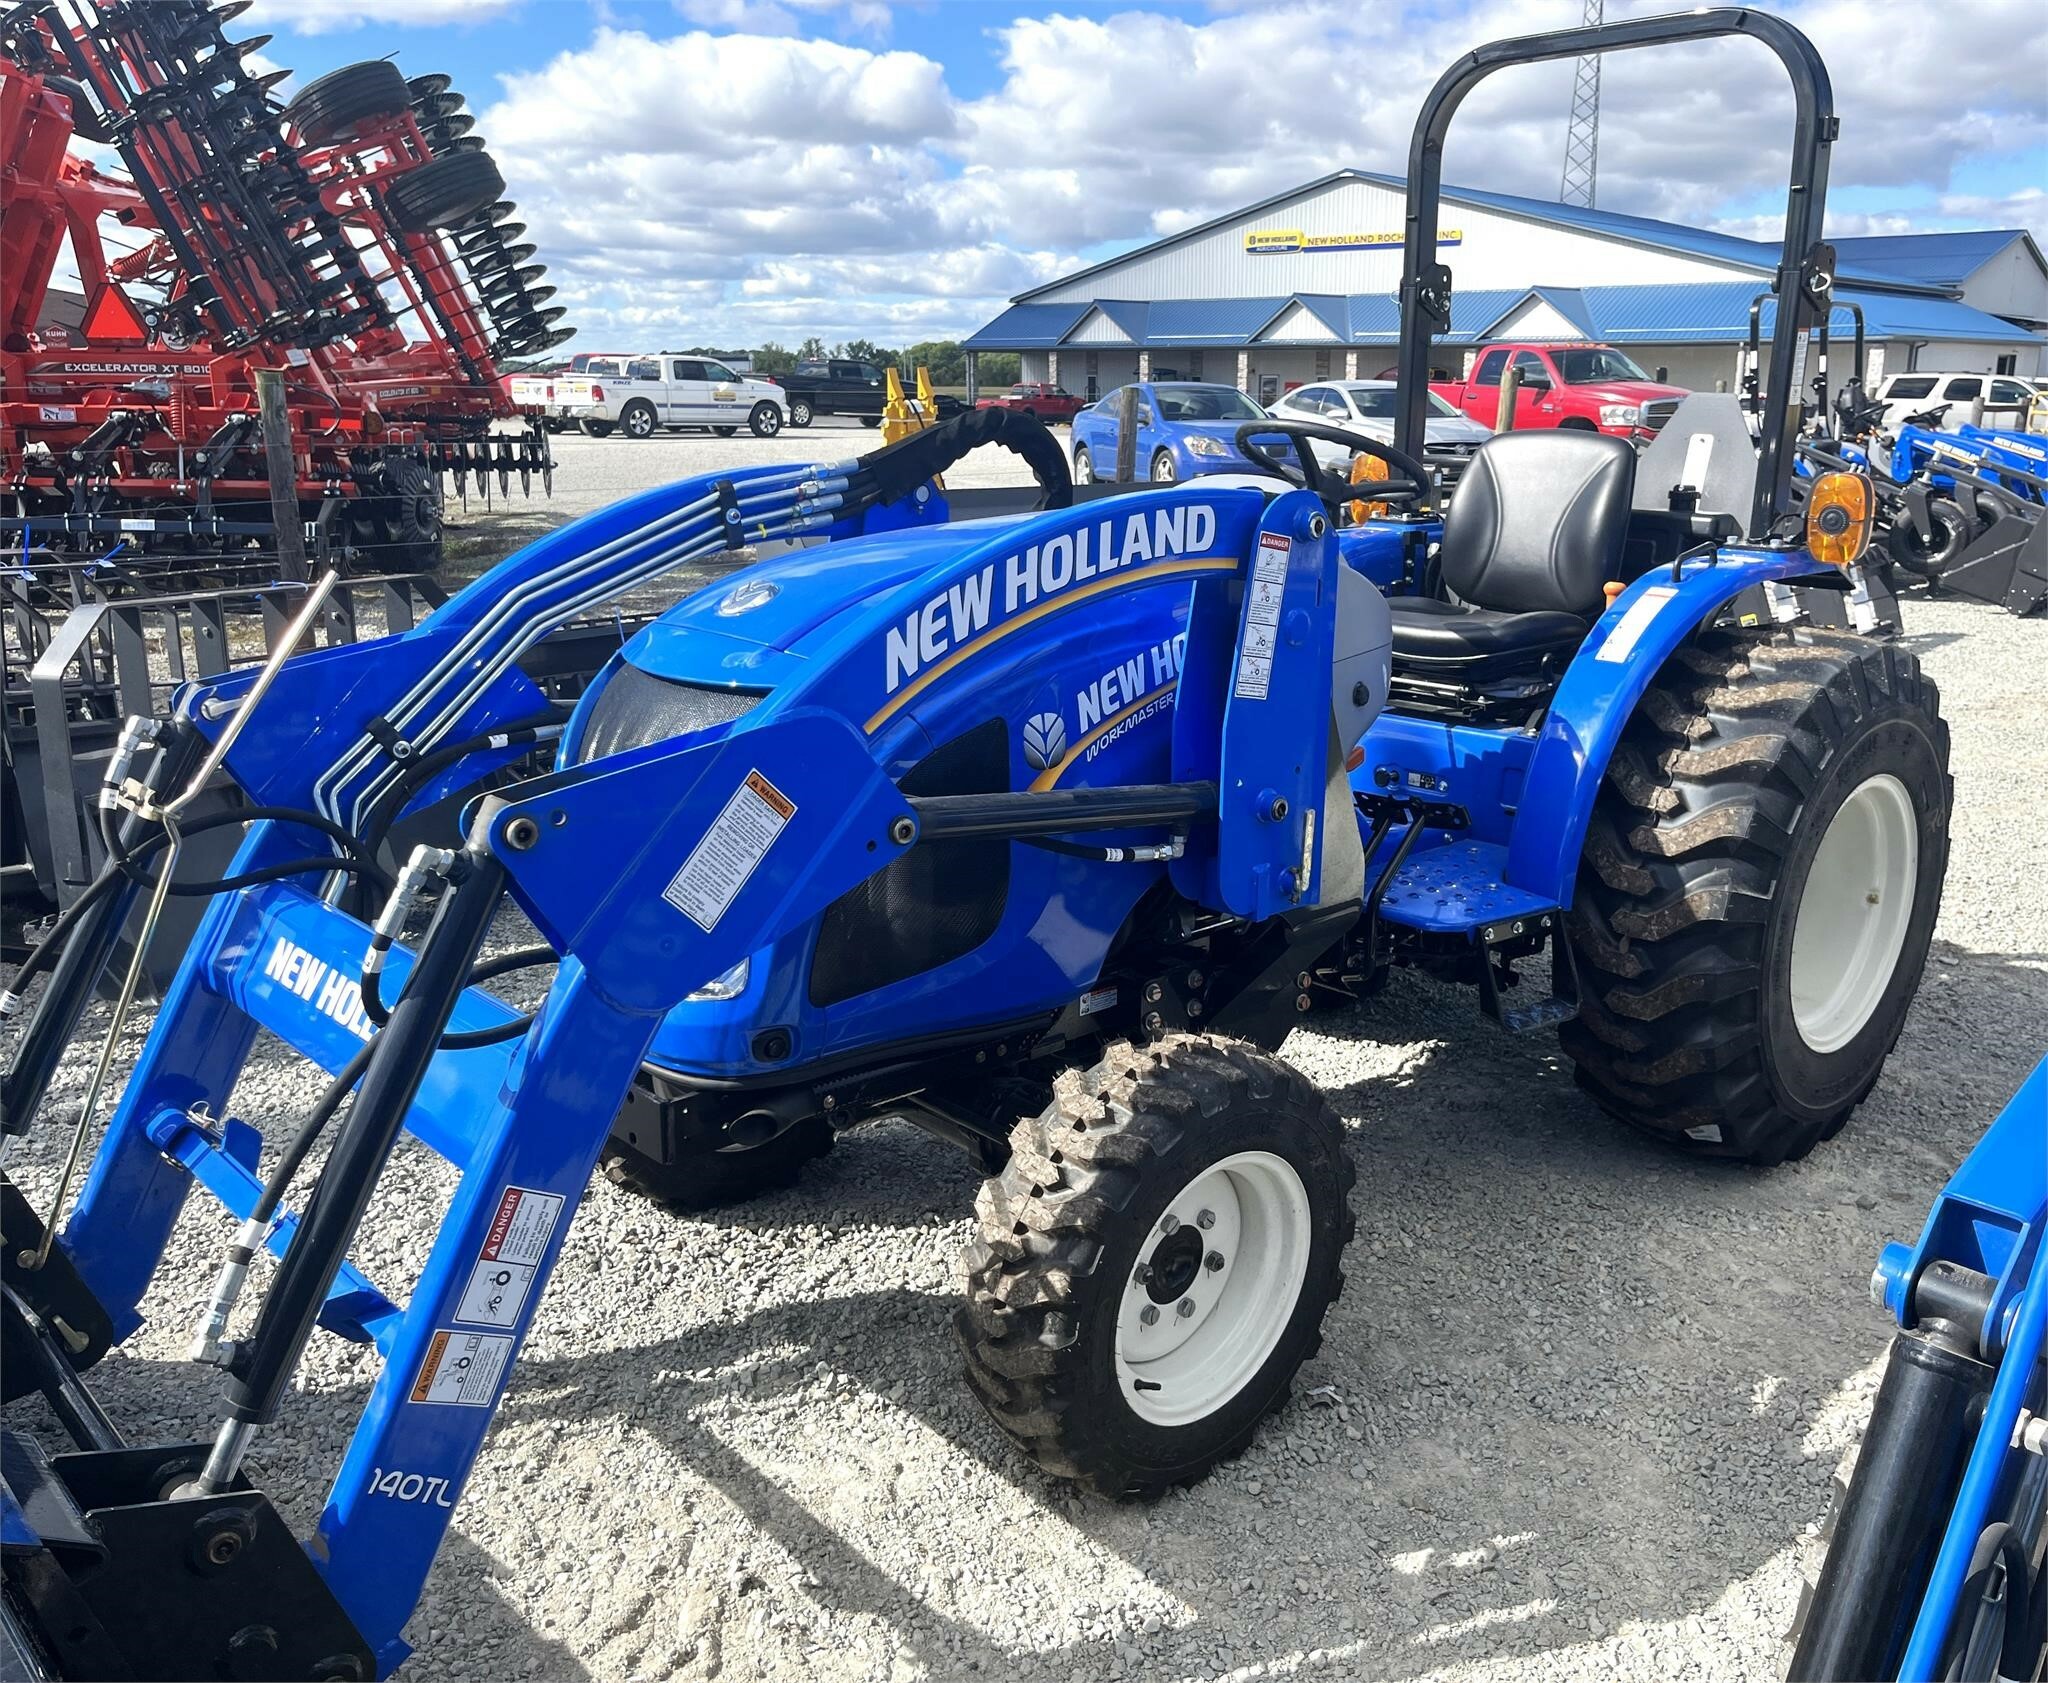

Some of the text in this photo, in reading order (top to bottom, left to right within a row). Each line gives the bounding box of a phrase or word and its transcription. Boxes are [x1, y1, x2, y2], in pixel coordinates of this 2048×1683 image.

[1308, 238, 1328, 246] NEW
[1329, 235, 1375, 245] HOLLAND
[65, 363, 157, 373] EXCELERATOR
[162, 364, 179, 373] XT
[1266, 537, 1290, 548] DANGER
[886, 505, 1217, 694] NEW HOLLAND
[1077, 653, 1146, 735] NEW
[1086, 692, 1175, 763] WORKMASTER
[759, 785, 790, 814] WARNING
[264, 936, 329, 1002] NEW
[491, 1194, 518, 1243] DANGER
[423, 1337, 446, 1384] WARNING
[367, 1467, 452, 1508] 140TL
